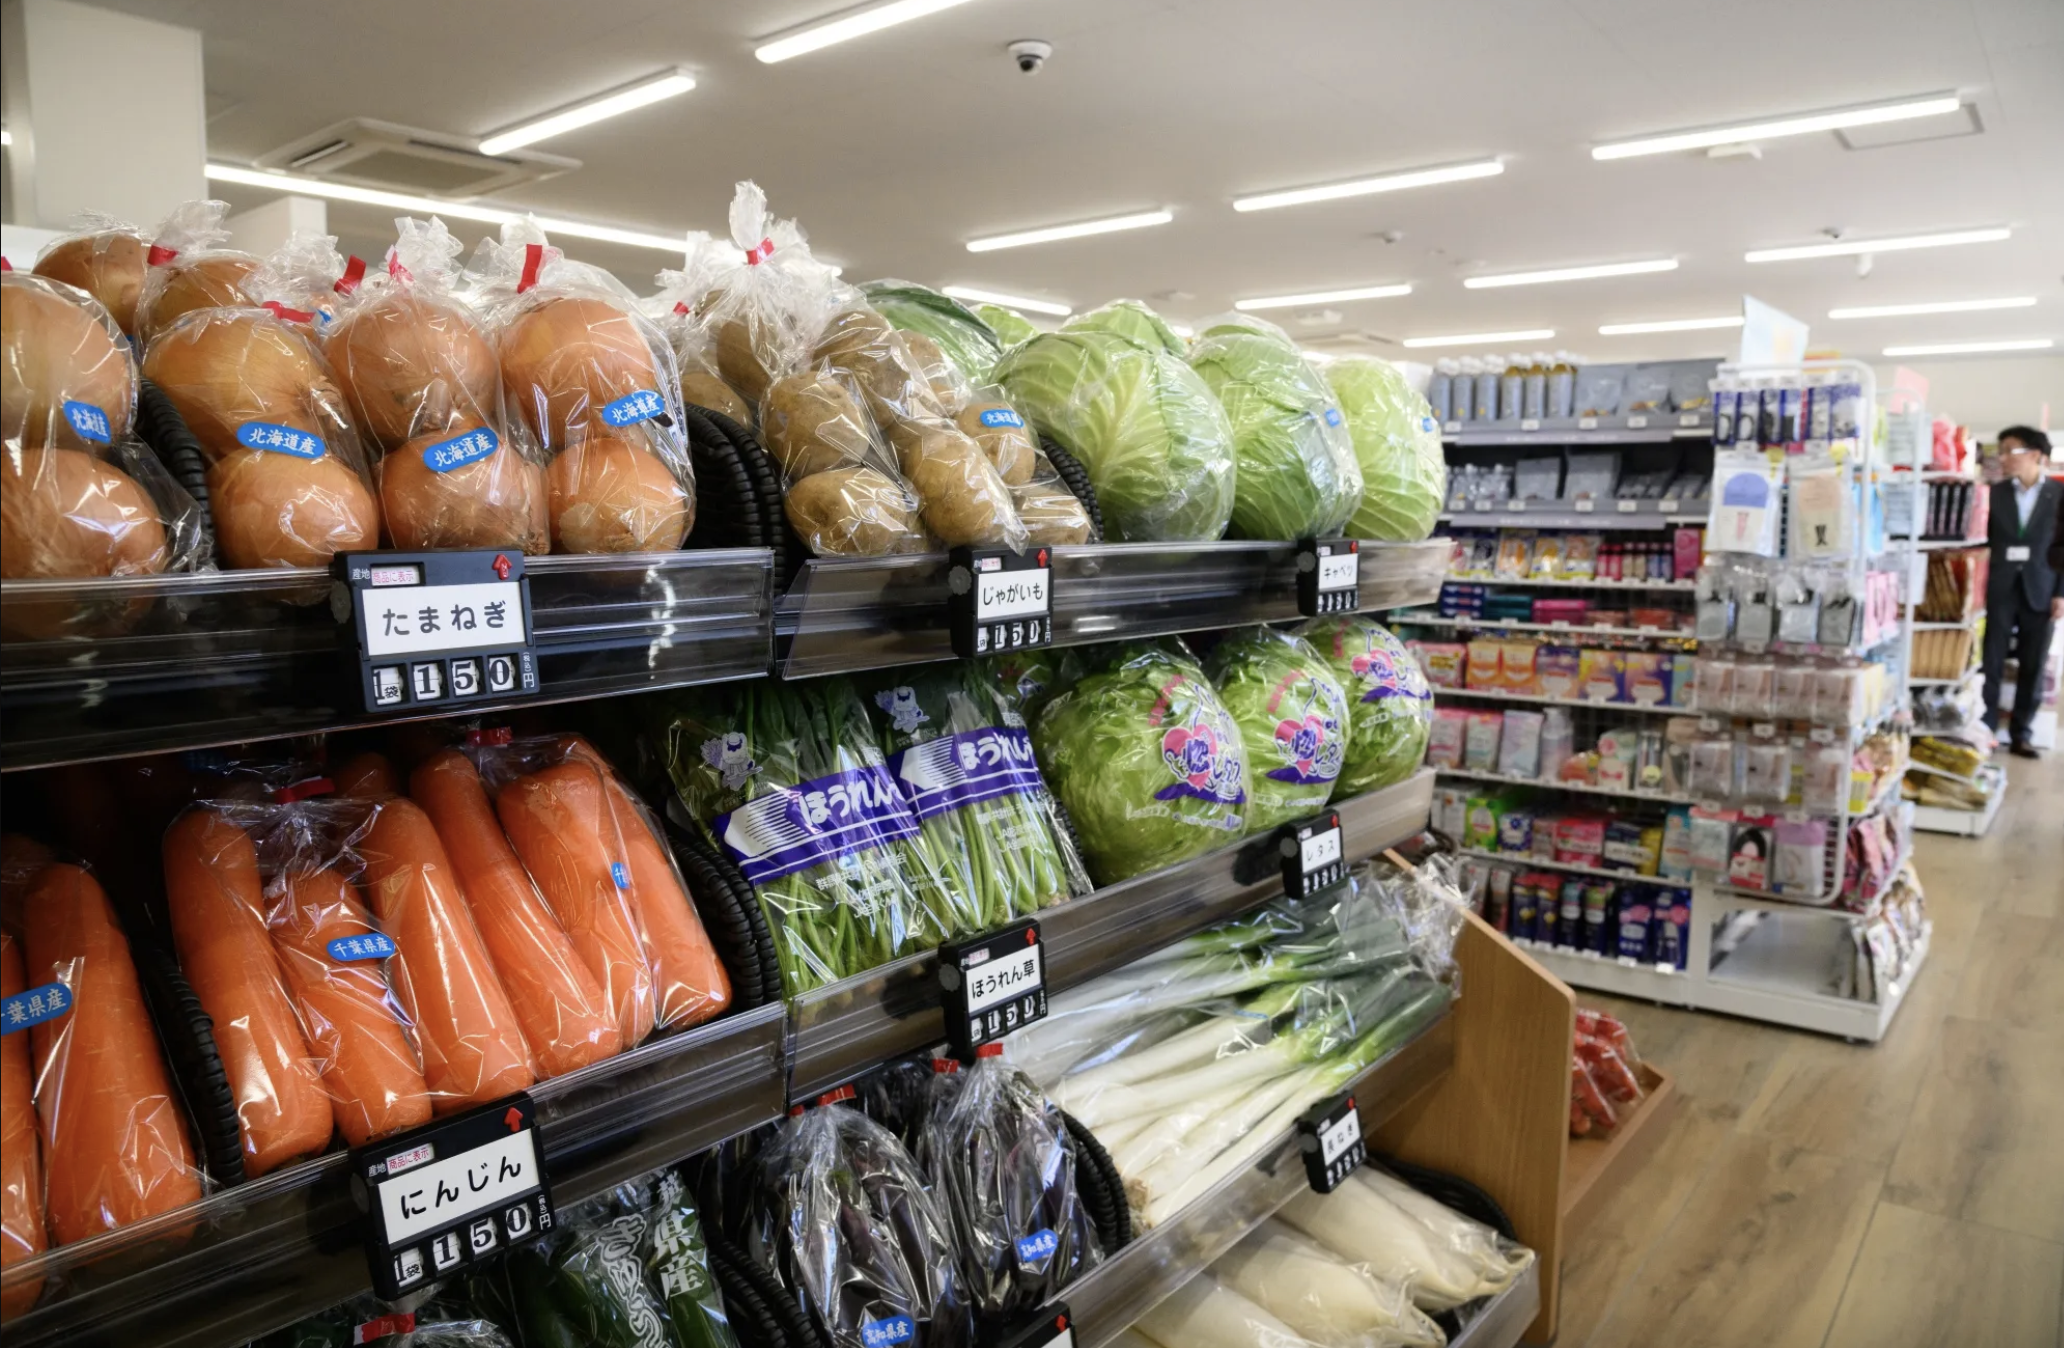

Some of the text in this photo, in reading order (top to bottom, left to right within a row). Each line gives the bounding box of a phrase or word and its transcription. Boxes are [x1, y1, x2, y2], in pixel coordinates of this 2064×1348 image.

[612, 393, 661, 424] 北海道産
[248, 427, 316, 455] 北海道産
[434, 433, 494, 467] 北海道産
[352, 568, 414, 583] 産地 商品に表示
[1324, 564, 1354, 580] キャベツ
[983, 583, 1043, 606] じゃがいも
[382, 599, 506, 637] たまねぎ
[798, 774, 906, 827] ほうれん
[1306, 840, 1335, 862] レタス
[333, 935, 392, 958] 千葉県産
[972, 959, 1035, 999] ほうれん草
[1, 988, 67, 1025] 葉県産
[368, 1147, 430, 1177] 産地 商品に表示
[400, 1156, 522, 1220] にんじん
[598, 1213, 668, 1348] きゅう
[865, 1320, 910, 1345] 高知県産
